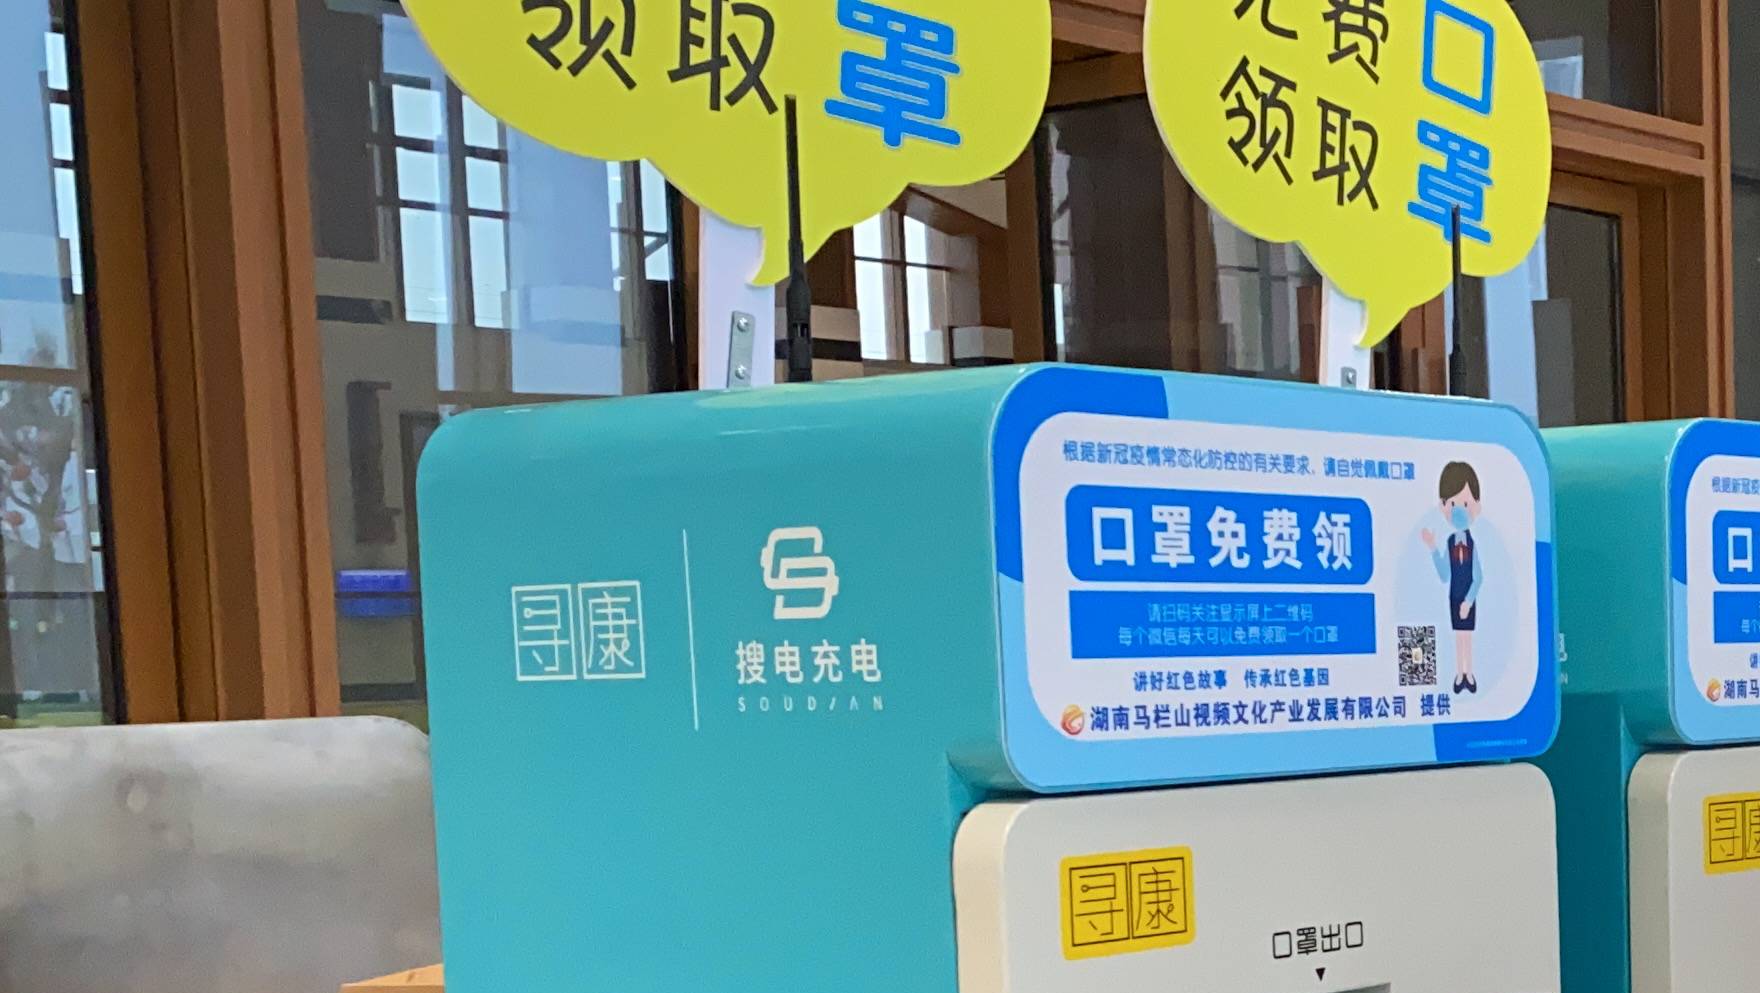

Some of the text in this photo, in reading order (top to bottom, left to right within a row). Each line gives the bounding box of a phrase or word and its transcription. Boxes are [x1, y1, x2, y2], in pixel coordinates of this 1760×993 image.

[1220, 55, 1379, 211] 领取
[1408, 0, 1494, 244] 口罩
[1092, 503, 1354, 569] 口罩免费领
[1118, 626, 1339, 647] 每个微信每天可以免费领取一个口罩
[736, 638, 881, 685] 搜电充电
[1133, 668, 1330, 692] 讲好红色故事 传承红色基因
[738, 695, 884, 712] SOUDIAN
[1090, 694, 1451, 732] 湖南马栏山视频文化产业发展有限公司 提供
[1273, 921, 1364, 960] 口罩出口
